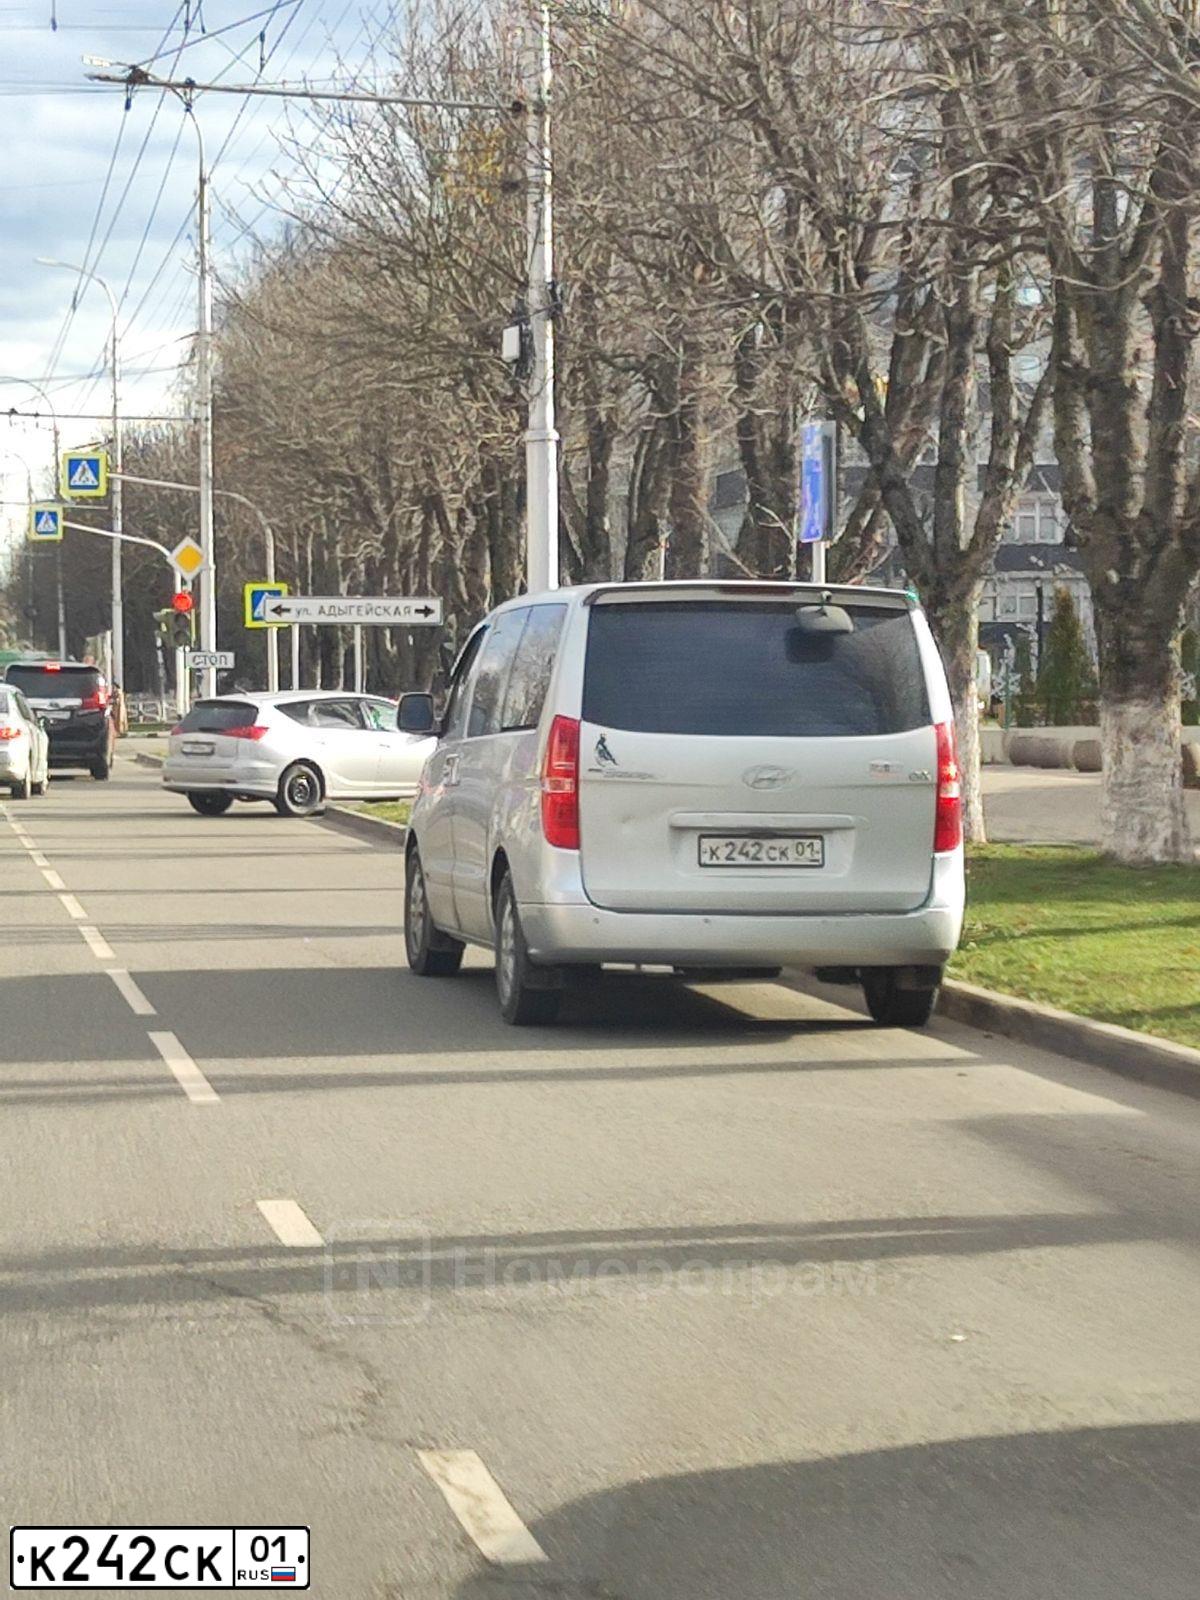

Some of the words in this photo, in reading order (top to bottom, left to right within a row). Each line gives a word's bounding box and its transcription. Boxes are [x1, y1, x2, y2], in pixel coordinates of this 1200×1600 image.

[318, 602, 411, 617] АДЫГЕЙСКАЯ
[192, 655, 228, 666] СТОП
[795, 841, 814, 857] 01
